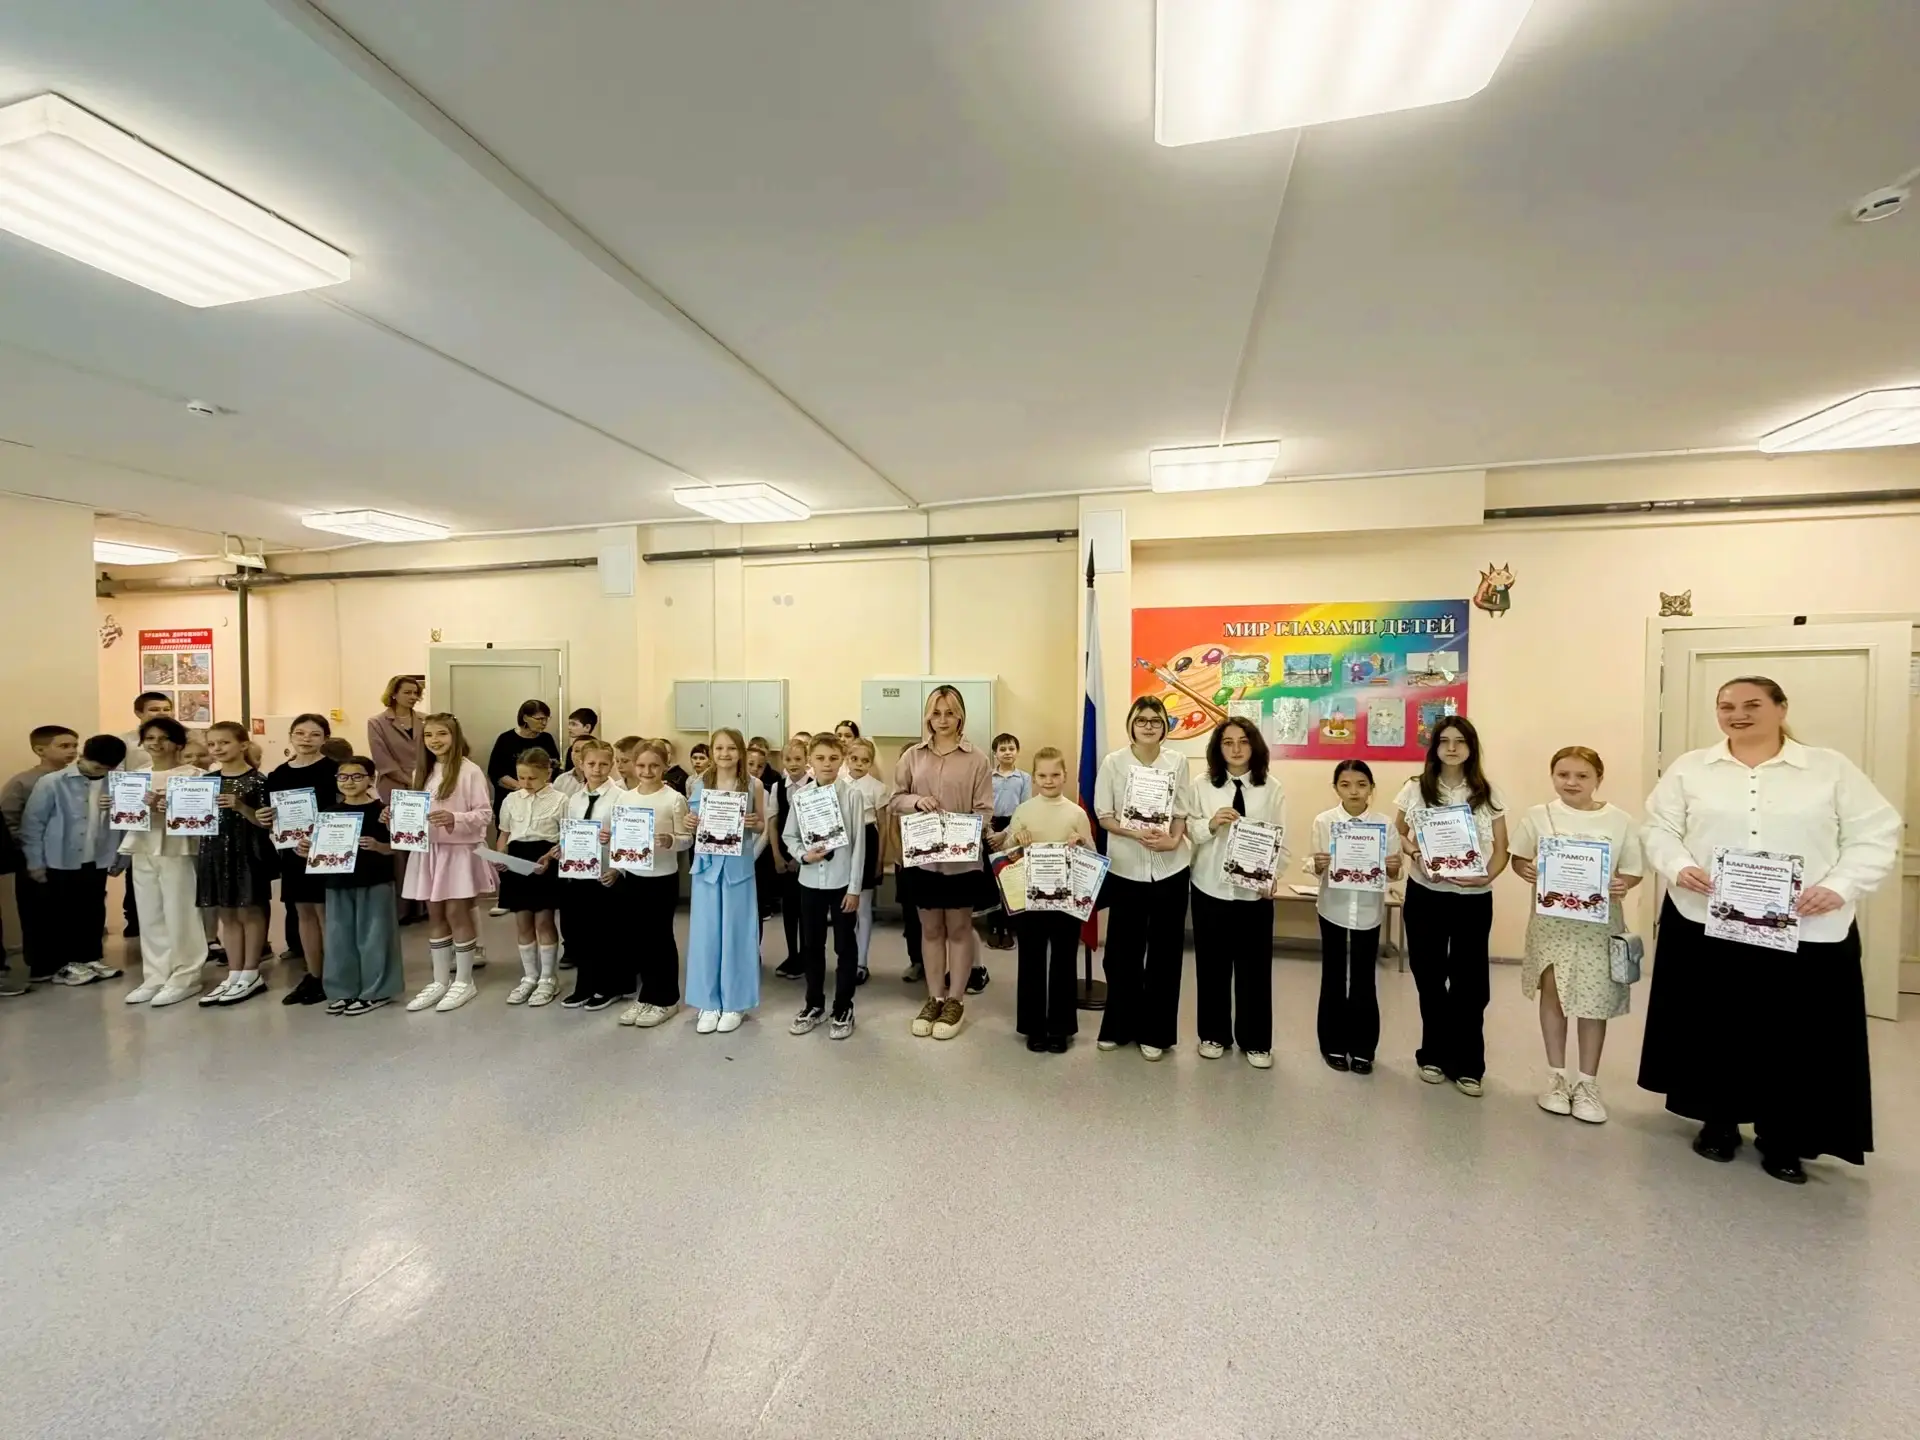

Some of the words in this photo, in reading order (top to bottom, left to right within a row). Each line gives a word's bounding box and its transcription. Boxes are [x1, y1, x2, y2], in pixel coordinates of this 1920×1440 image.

[1223, 621, 1271, 638] МИР
[1274, 618, 1377, 637] ГЛАЗАМИ
[1379, 614, 1457, 639] ДЕТЕЙ
[1429, 818, 1461, 828] ГРАМОТА
[1557, 853, 1595, 862] ГРАМОТА
[1073, 858, 1097, 872] ГРАМОТА
[1726, 861, 1790, 873] БЛАГОДАРНОСТЬ
